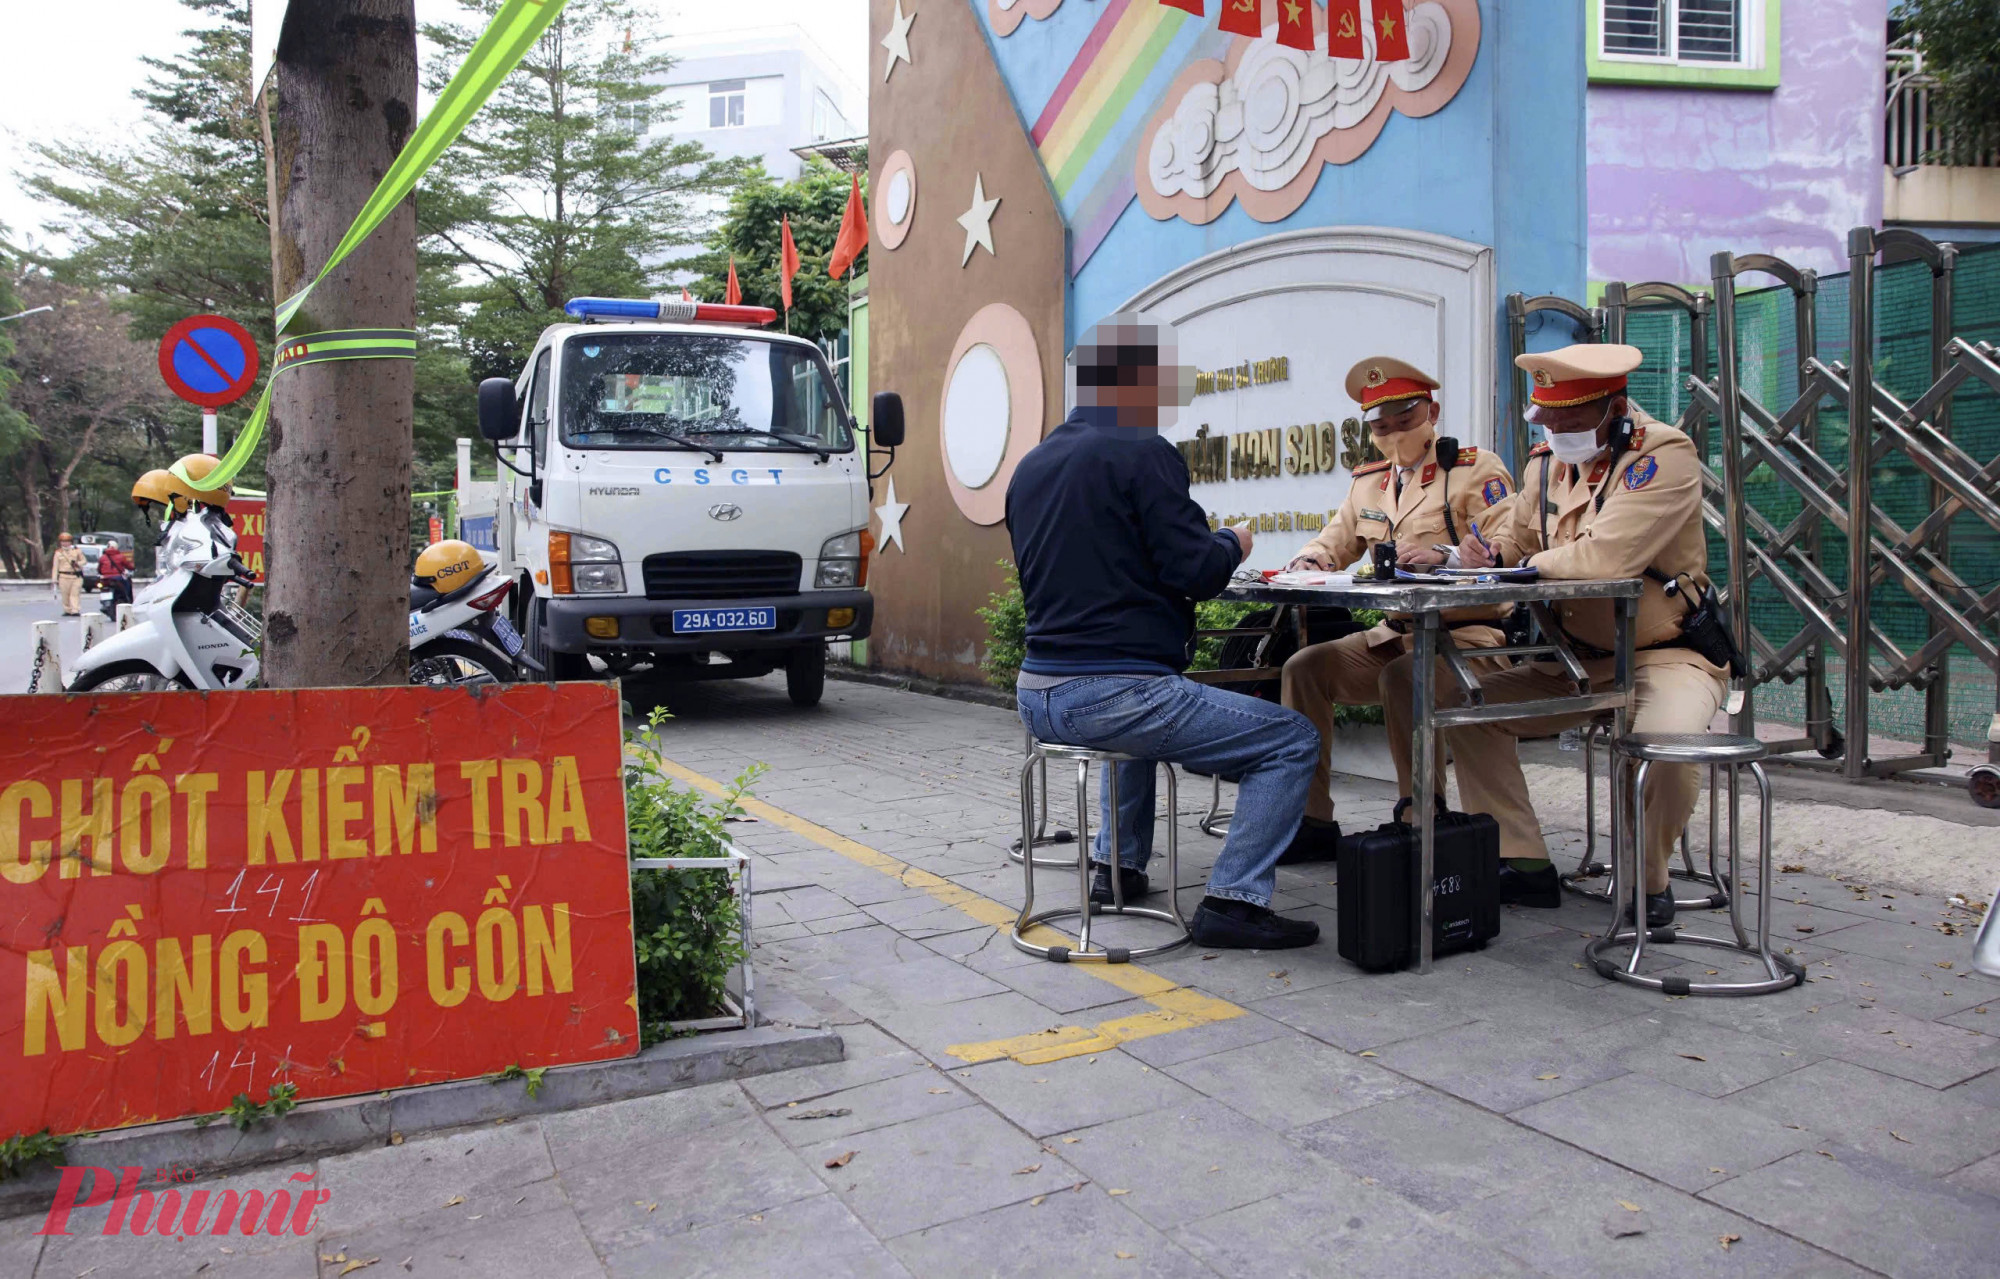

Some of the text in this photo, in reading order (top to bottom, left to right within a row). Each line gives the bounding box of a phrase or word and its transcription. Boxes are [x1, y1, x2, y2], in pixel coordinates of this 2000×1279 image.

[1230, 427, 1282, 480] NON
[589, 487, 640, 496] HYUNDAI
[1259, 511, 1278, 532] Hai
[437, 561, 470, 579] CSGT
[682, 611, 767, 628] 29A-032.60
[0, 726, 592, 884] CHỐT KIỂM TRA
[23, 875, 574, 1056] NỒNG ĐỘ CỒN
